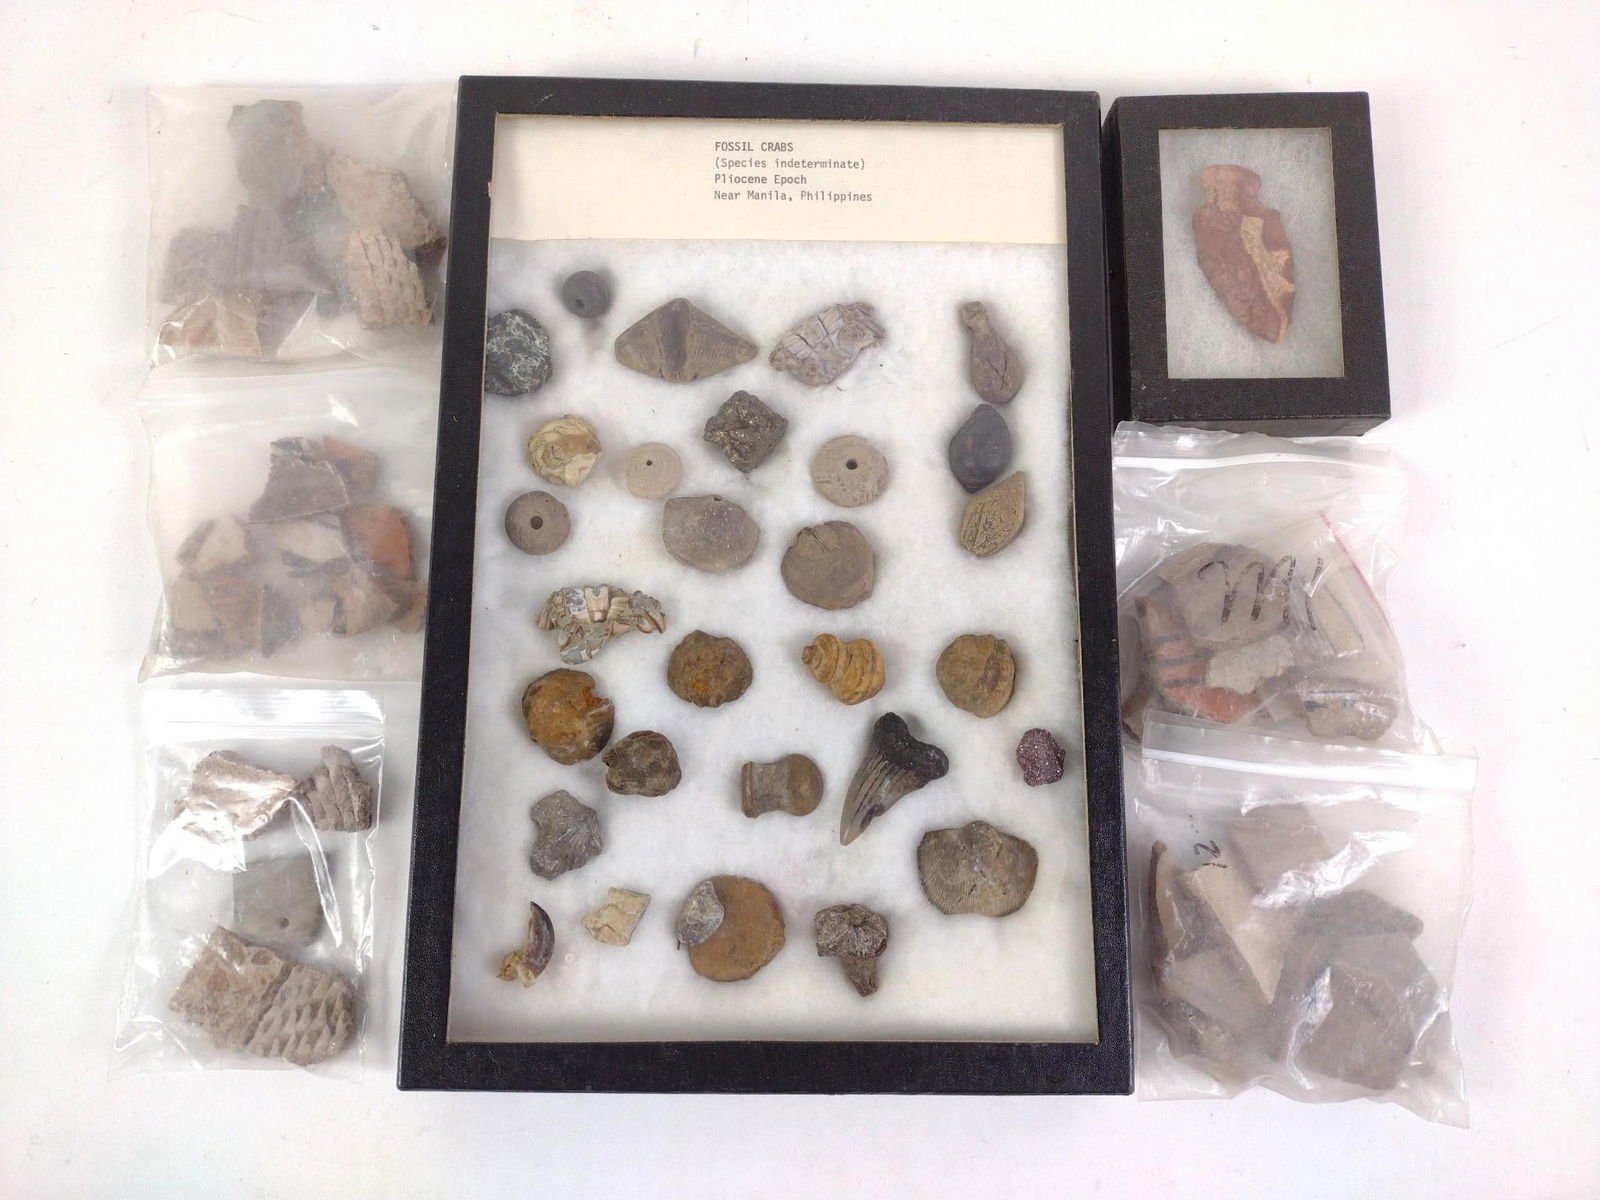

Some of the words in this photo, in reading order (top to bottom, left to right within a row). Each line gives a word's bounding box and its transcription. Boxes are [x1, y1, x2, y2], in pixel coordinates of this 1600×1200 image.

[715, 142, 754, 152] FOSSIL
[761, 142, 794, 152] CRABS
[715, 157, 767, 170] (Species
[775, 158, 865, 171] indeterminate)
[714, 174, 768, 184] Pliocene
[774, 174, 807, 186] Epoch
[714, 190, 741, 201] Near
[747, 190, 793, 202] Manila,
[801, 191, 873, 203] Philippines
